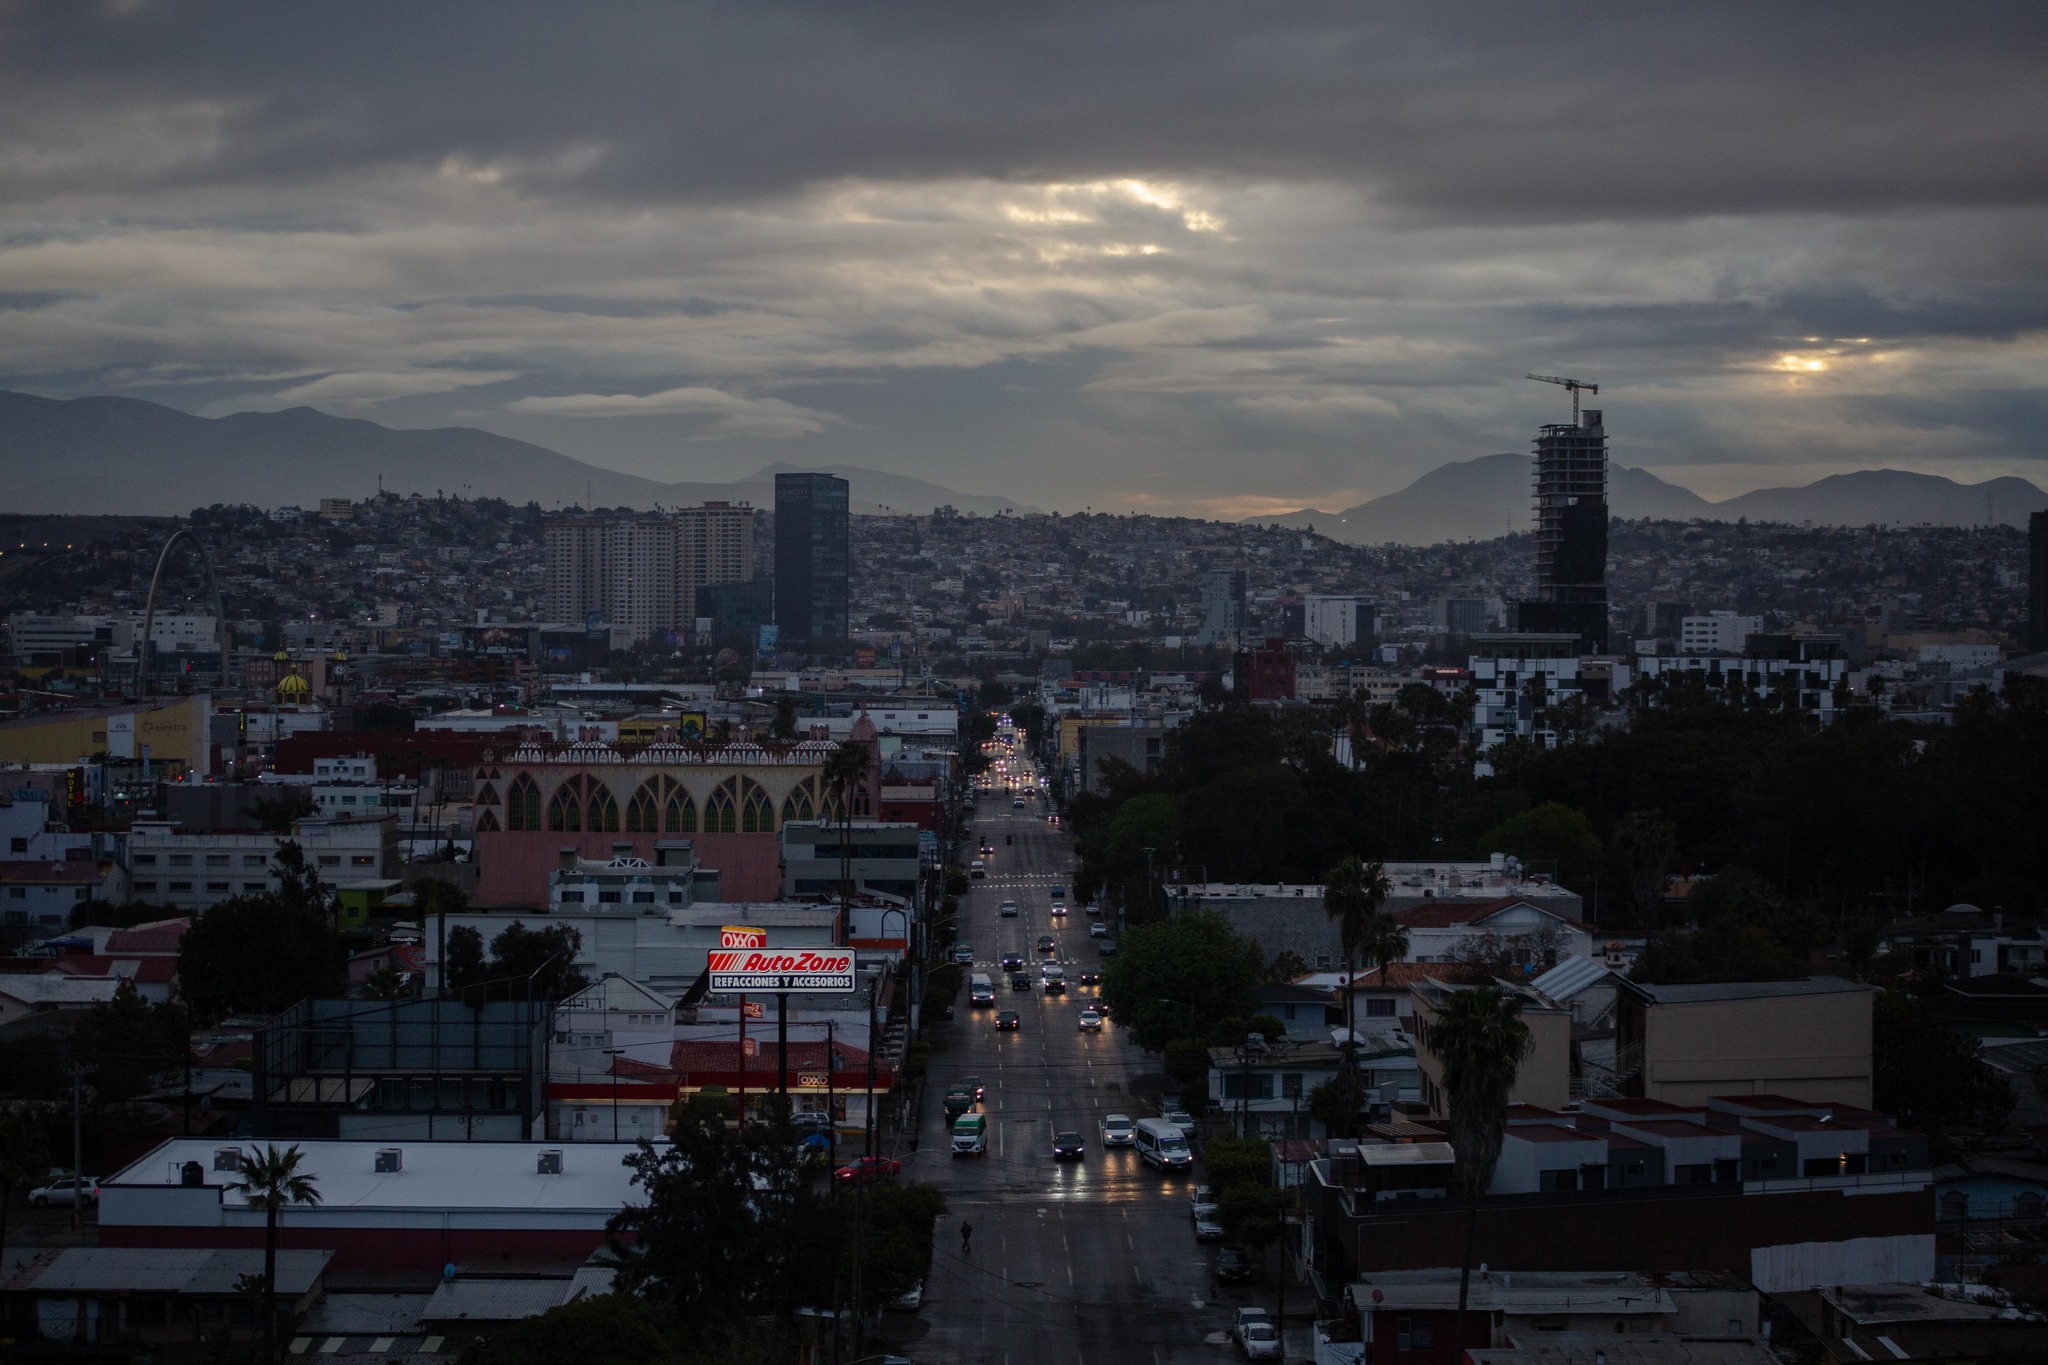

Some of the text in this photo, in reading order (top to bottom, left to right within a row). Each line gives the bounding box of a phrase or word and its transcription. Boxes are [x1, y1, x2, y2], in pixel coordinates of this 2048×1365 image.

[155, 722, 187, 732] elektra
[67, 771, 75, 807] MOTEL
[722, 933, 759, 948] OXXO
[742, 953, 850, 971] AutoZone
[714, 976, 851, 987] REFACCIONES Y ACCESORIOS
[800, 1075, 828, 1086] OXXO
